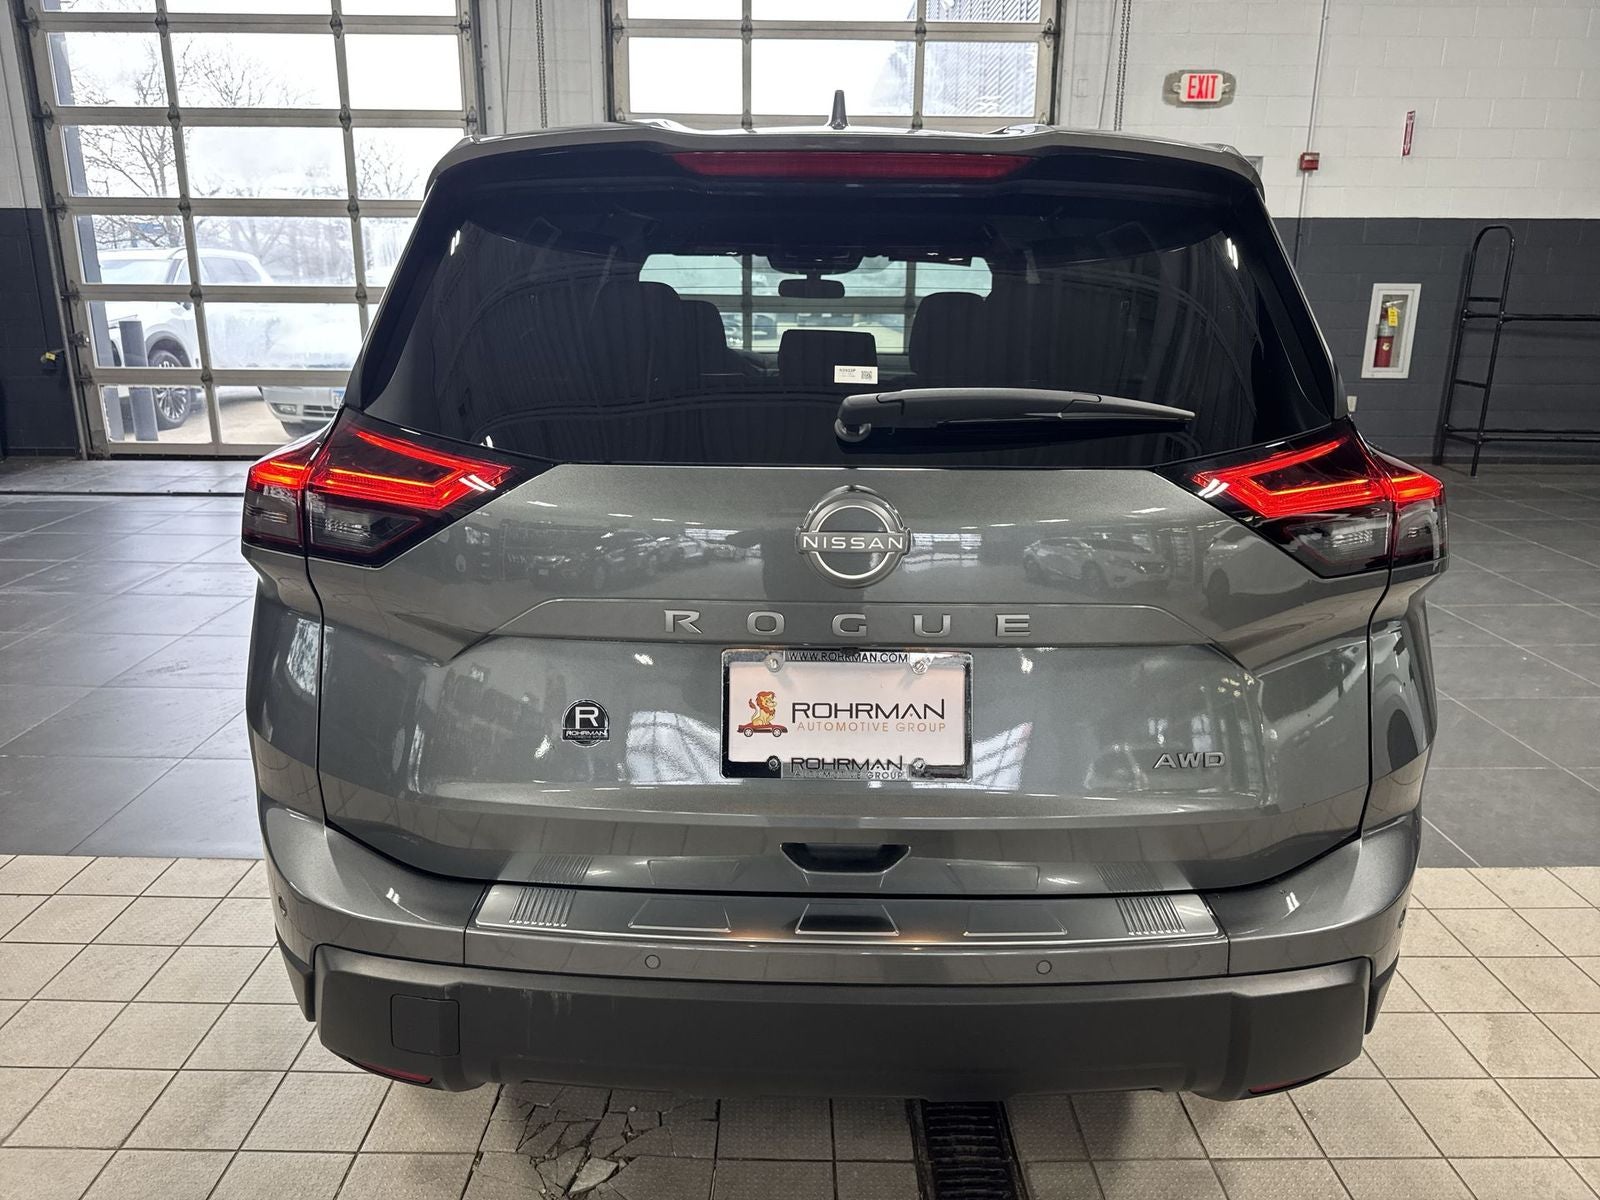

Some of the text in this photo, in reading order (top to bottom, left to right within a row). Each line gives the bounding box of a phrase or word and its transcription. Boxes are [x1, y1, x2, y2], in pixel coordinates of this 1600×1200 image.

[1187, 75, 1219, 99] EXIT
[802, 536, 904, 549] NISSAN
[664, 609, 1032, 638] ROGUE
[575, 706, 599, 729] R
[792, 698, 945, 724] ROHRMAN
[797, 721, 946, 732] AUTOMOTIVE GROUP
[791, 755, 903, 773] ROHRMAN
[1153, 752, 1226, 768] AWD
[867, 771, 903, 780] GROUP
